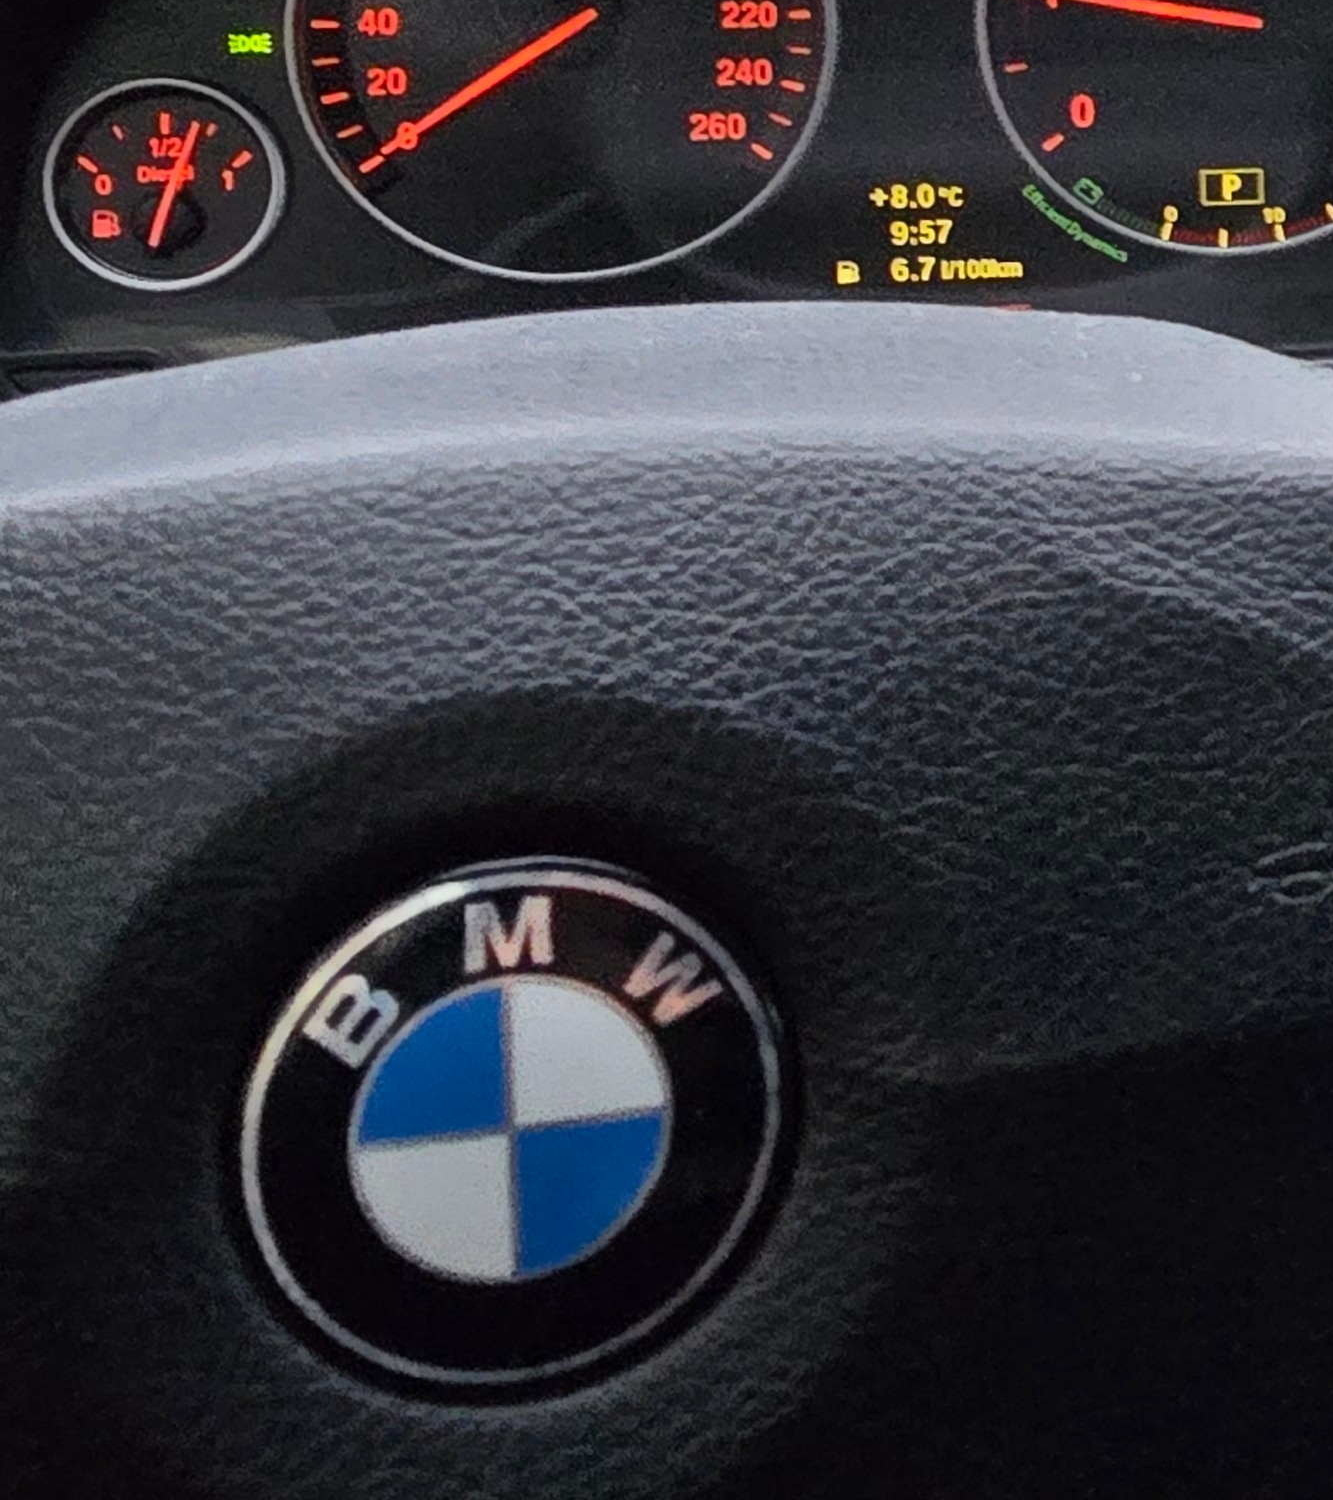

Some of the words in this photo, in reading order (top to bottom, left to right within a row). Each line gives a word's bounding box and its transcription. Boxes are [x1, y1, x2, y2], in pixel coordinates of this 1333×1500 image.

[358, 8, 399, 36] 40
[721, 1, 777, 28] 220
[367, 66, 407, 96] 20
[717, 58, 772, 86] 240
[1070, 94, 1095, 128] 0
[690, 112, 746, 141] 260
[149, 137, 183, 159] 1/2
[95, 174, 112, 195] 0
[222, 170, 233, 190] 1
[1221, 171, 1242, 201] P
[1164, 206, 1178, 222] 0
[1263, 207, 1285, 223] 10
[890, 219, 952, 245] 9:57
[890, 256, 935, 282] 6.7
